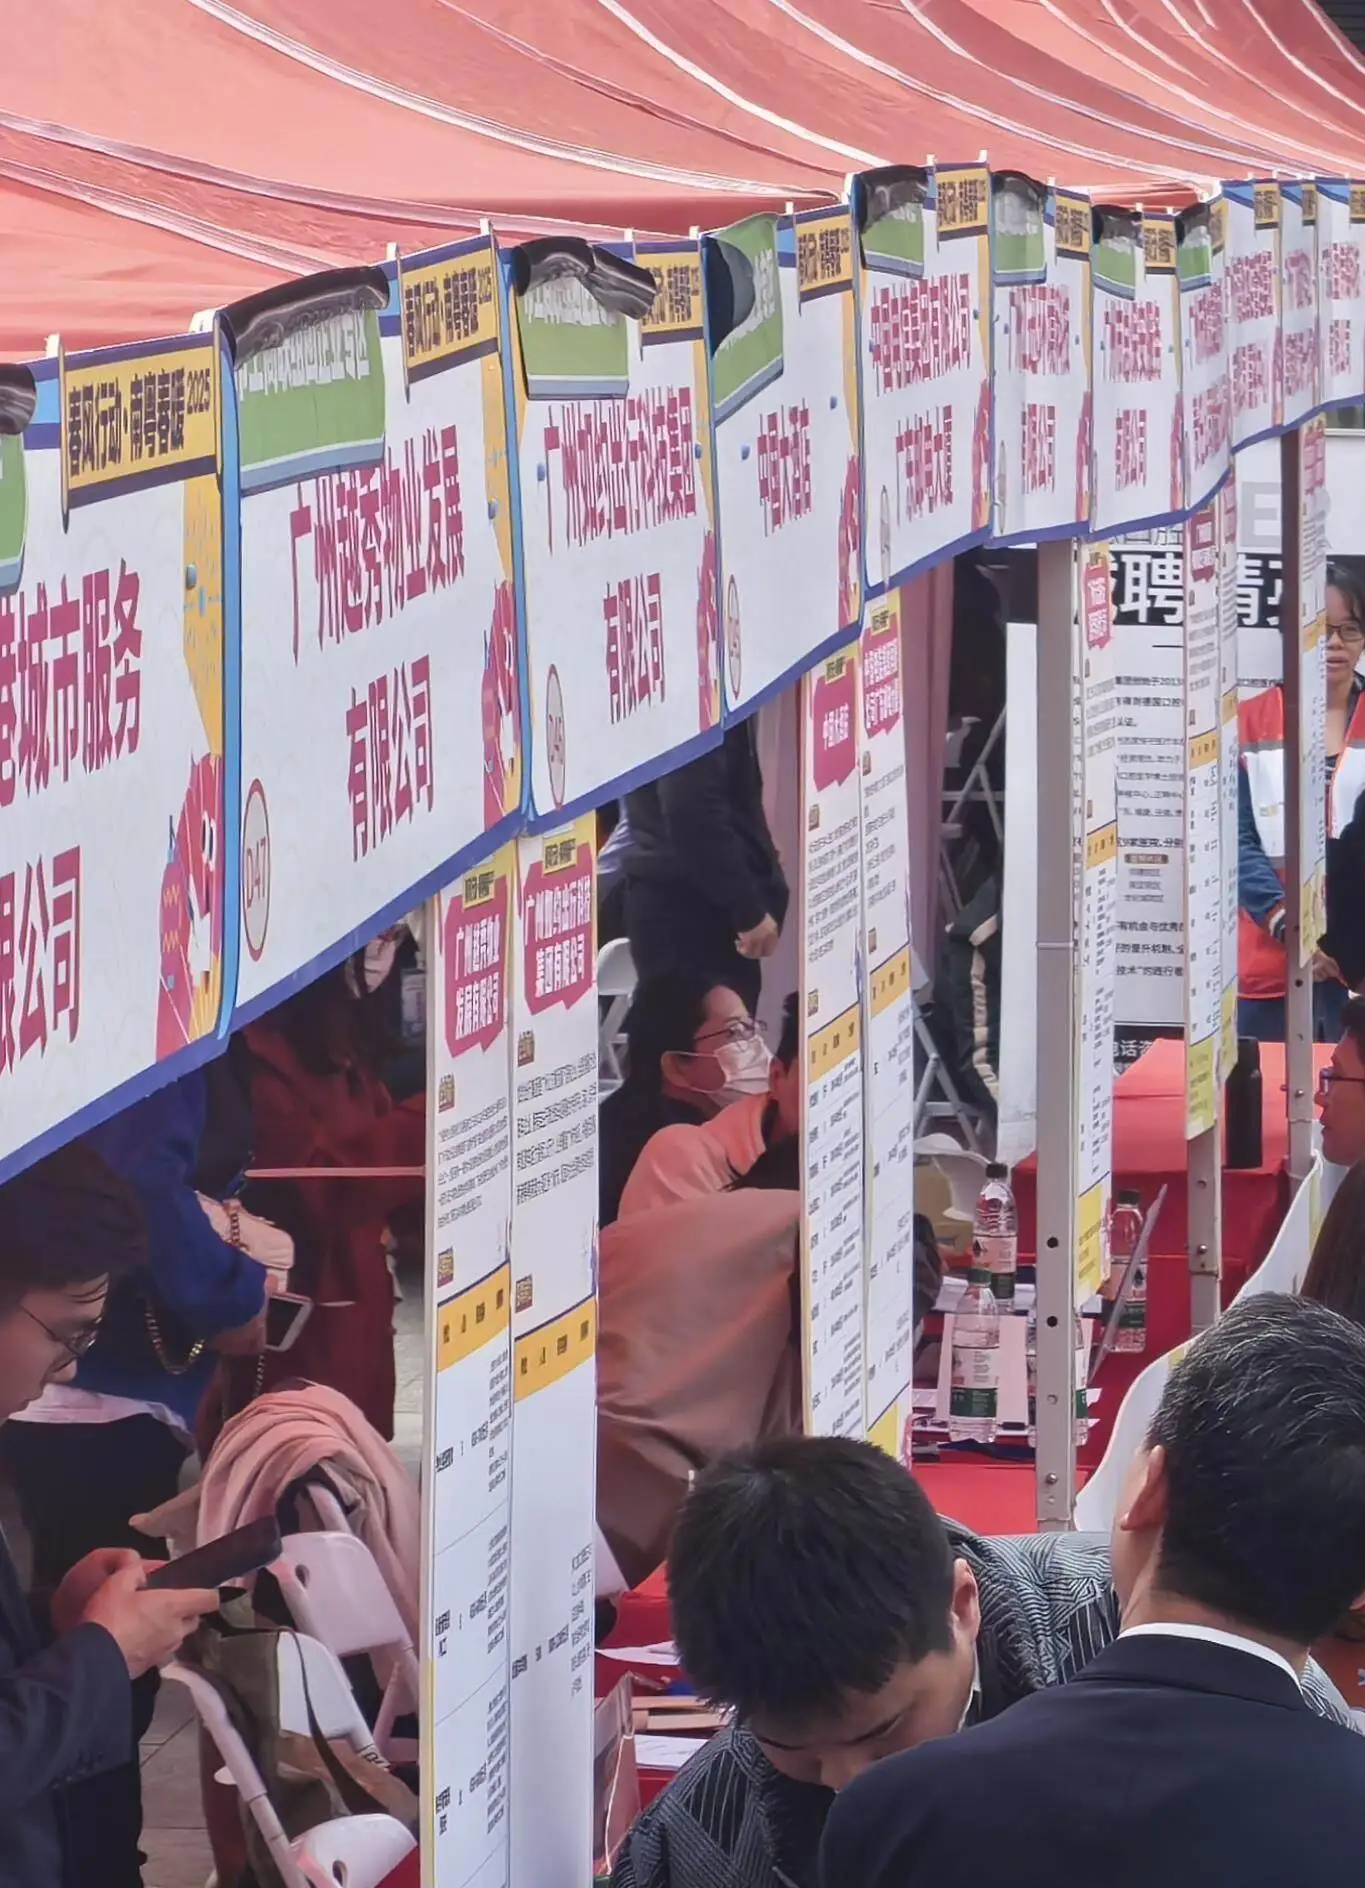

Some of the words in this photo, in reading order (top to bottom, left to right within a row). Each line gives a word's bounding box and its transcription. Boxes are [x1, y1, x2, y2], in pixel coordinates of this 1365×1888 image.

[186, 367, 212, 417] 2025
[289, 424, 467, 665] 广州越秀物业发展
[603, 572, 665, 725] 有限公司
[345, 654, 434, 862] 有限公司
[246, 836, 267, 909] D47
